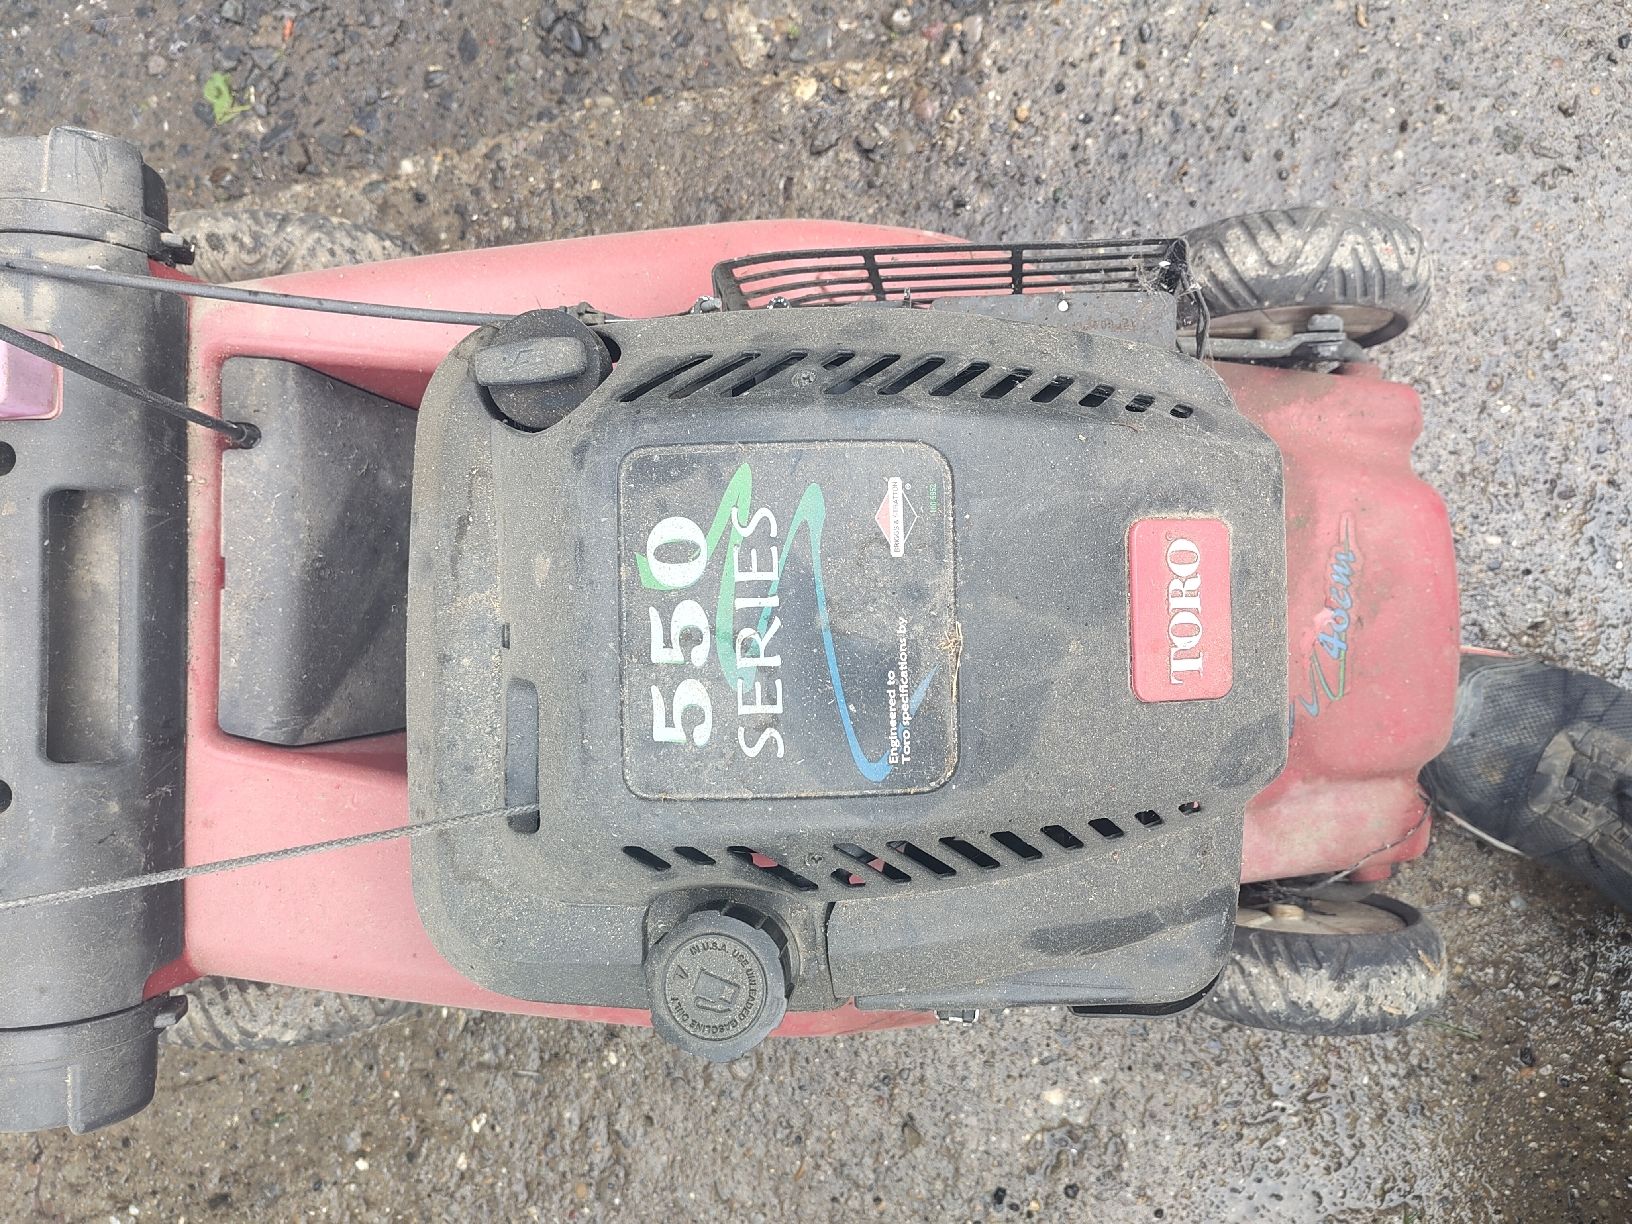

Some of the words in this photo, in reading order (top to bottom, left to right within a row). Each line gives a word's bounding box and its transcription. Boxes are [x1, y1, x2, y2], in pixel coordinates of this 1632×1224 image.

[893, 525, 901, 553] BRIGGS
[646, 516, 713, 747] 550
[731, 507, 785, 758] SERIES
[897, 617, 908, 634] by
[1166, 538, 1204, 685] TORO
[887, 670, 896, 685] to
[898, 639, 912, 726] specifications
[886, 689, 899, 764] Engineered
[901, 729, 911, 764] Toro
[732, 949, 749, 967] USE
